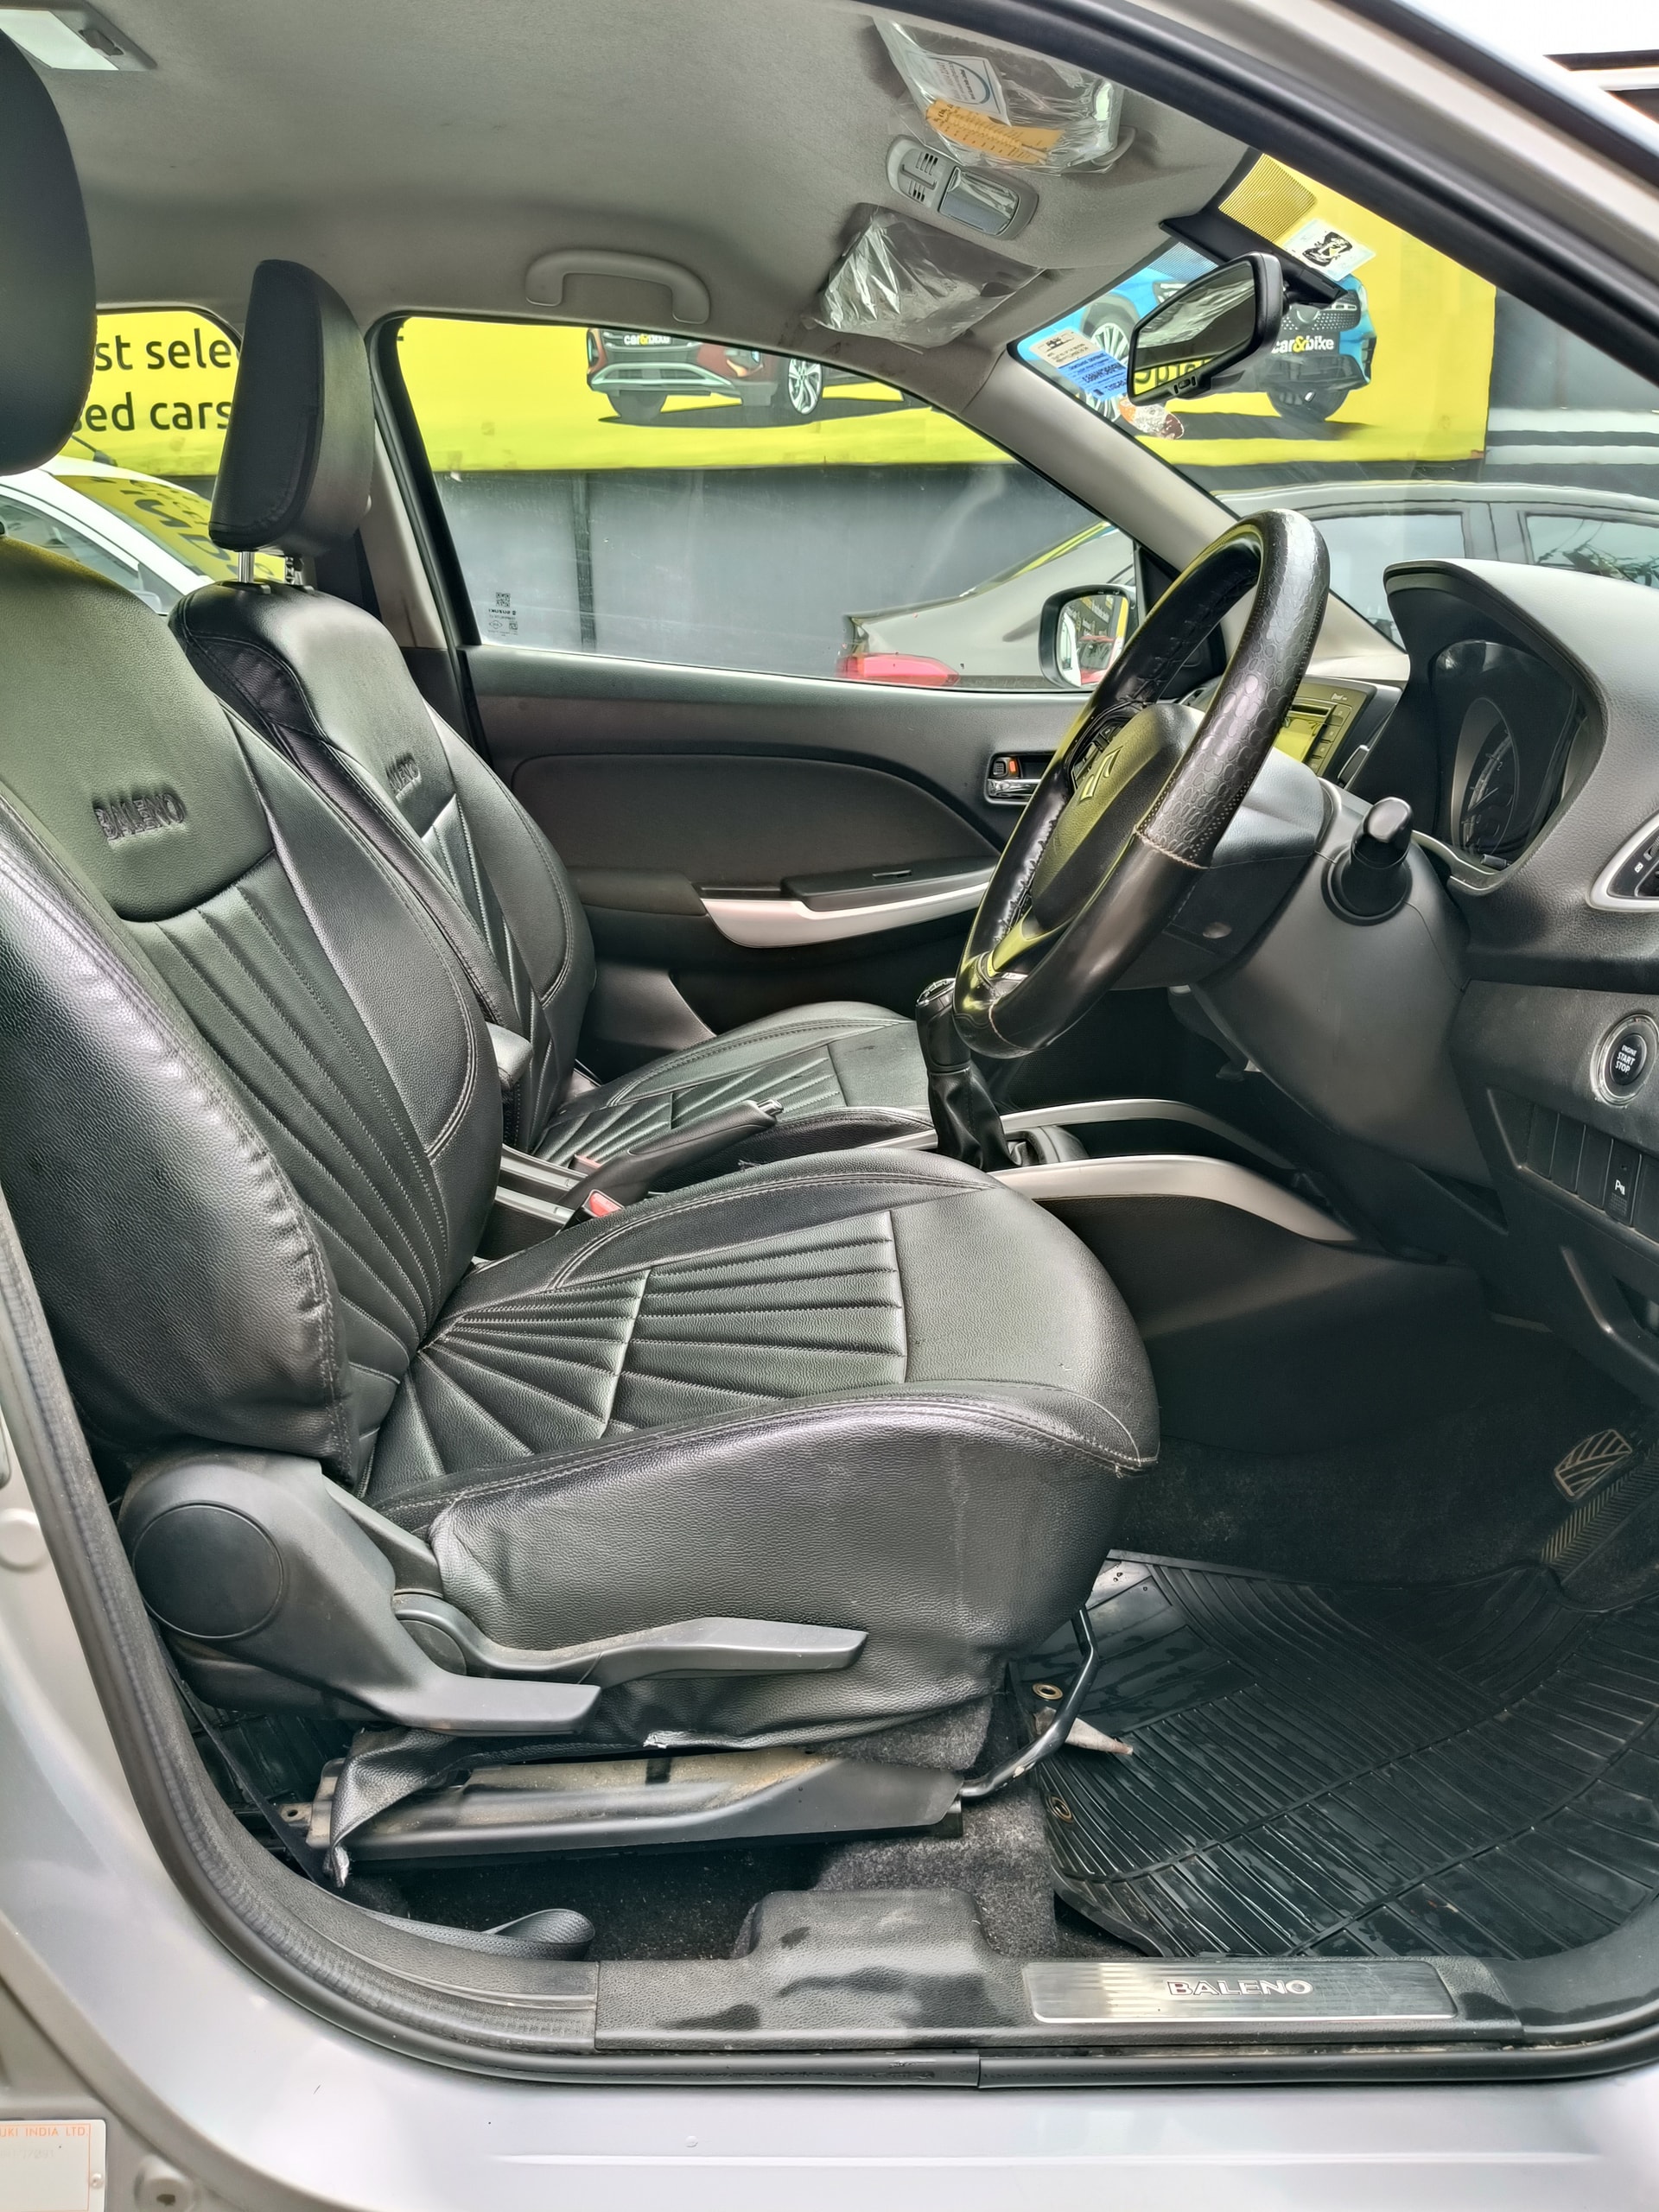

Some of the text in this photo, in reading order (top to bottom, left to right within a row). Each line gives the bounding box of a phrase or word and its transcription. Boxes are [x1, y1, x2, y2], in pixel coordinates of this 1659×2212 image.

[145, 327, 238, 370] sele
[149, 401, 232, 430] cars
[92, 790, 185, 842] BALENO
[1621, 1045, 1637, 1057] ENGINE
[1615, 1060, 1630, 1073] STOP
[1617, 1052, 1636, 1066] START
[1166, 1979, 1314, 1996] BALENO
[25, 2127, 59, 2137] INDIA
